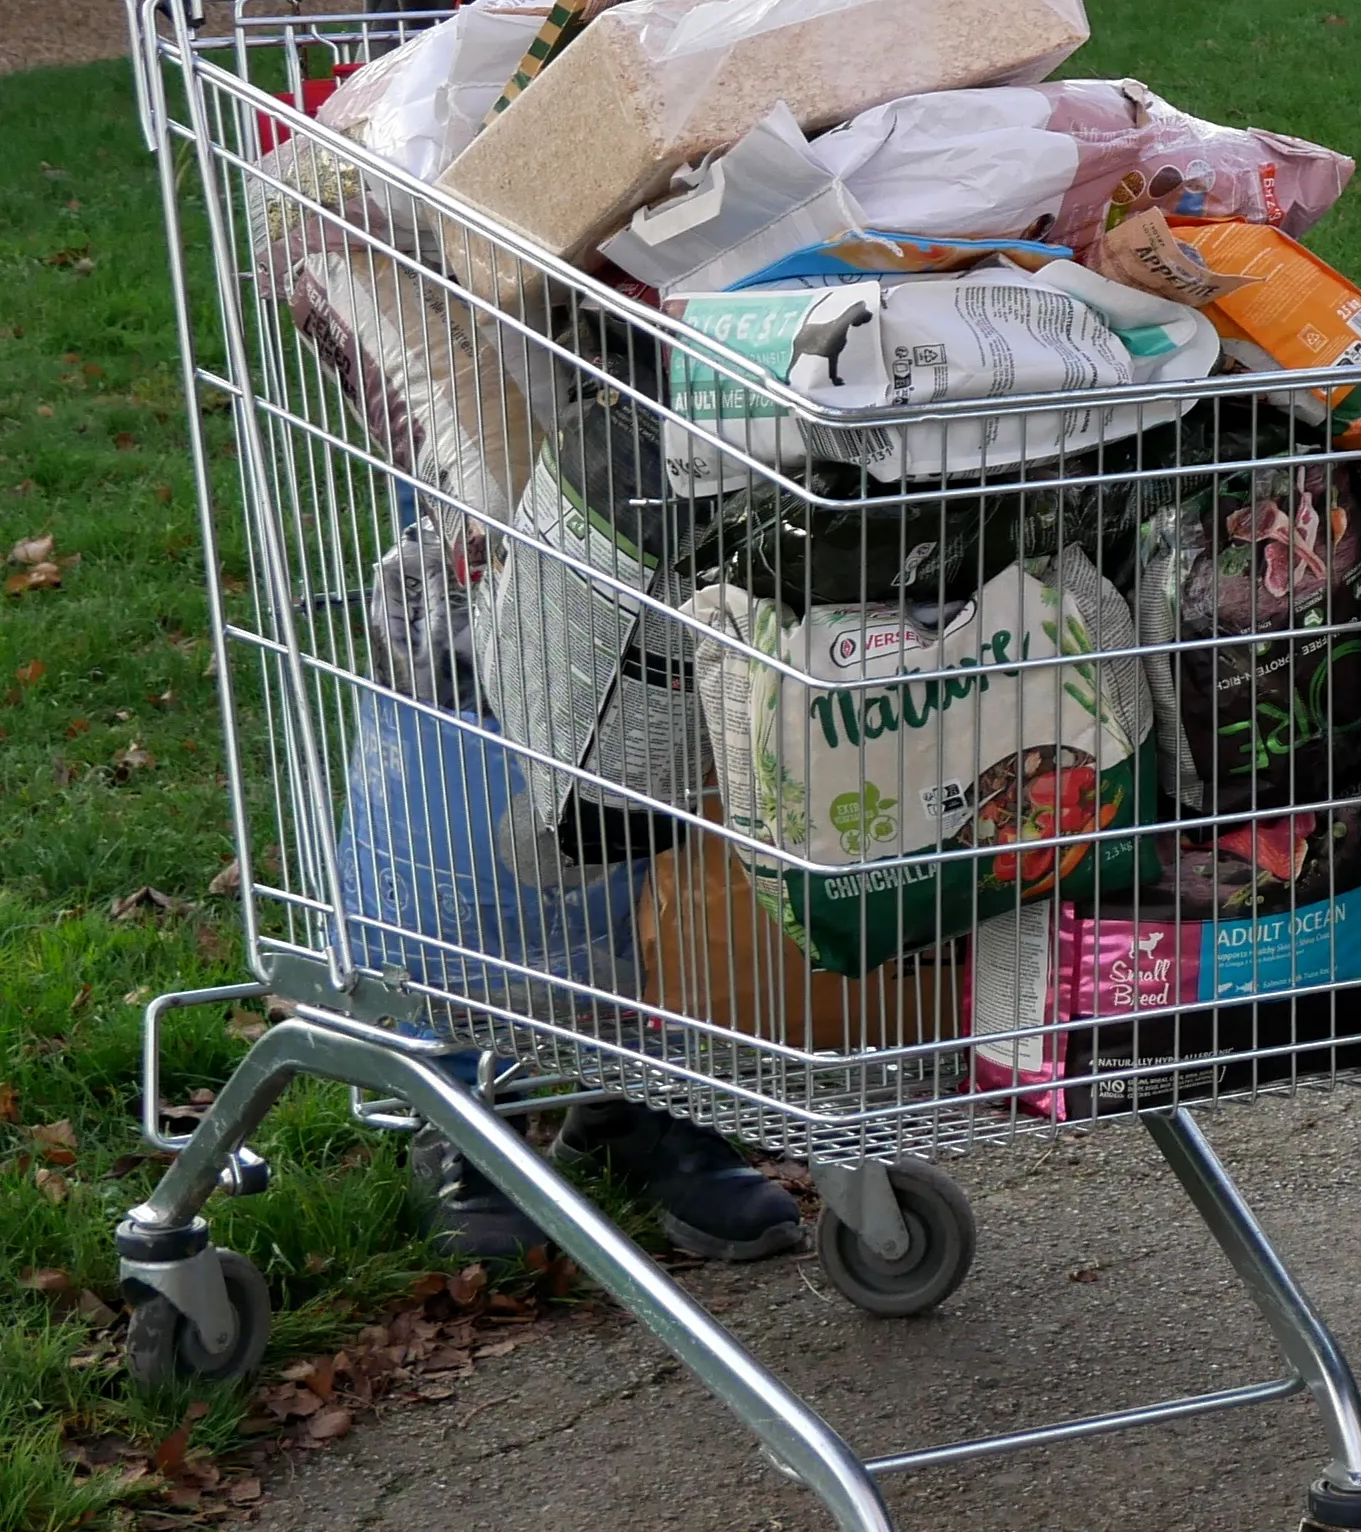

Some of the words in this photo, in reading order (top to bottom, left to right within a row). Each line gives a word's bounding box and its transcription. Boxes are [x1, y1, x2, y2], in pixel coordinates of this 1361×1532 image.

[1216, 655, 1292, 692] PROTEN-RICH
[1217, 920, 1285, 948] ADULT
[1287, 903, 1347, 936] OCEAN
[1217, 950, 1248, 962] upports
[1110, 983, 1169, 1007] Beed
[1097, 1056, 1153, 1068] NATURALLY
